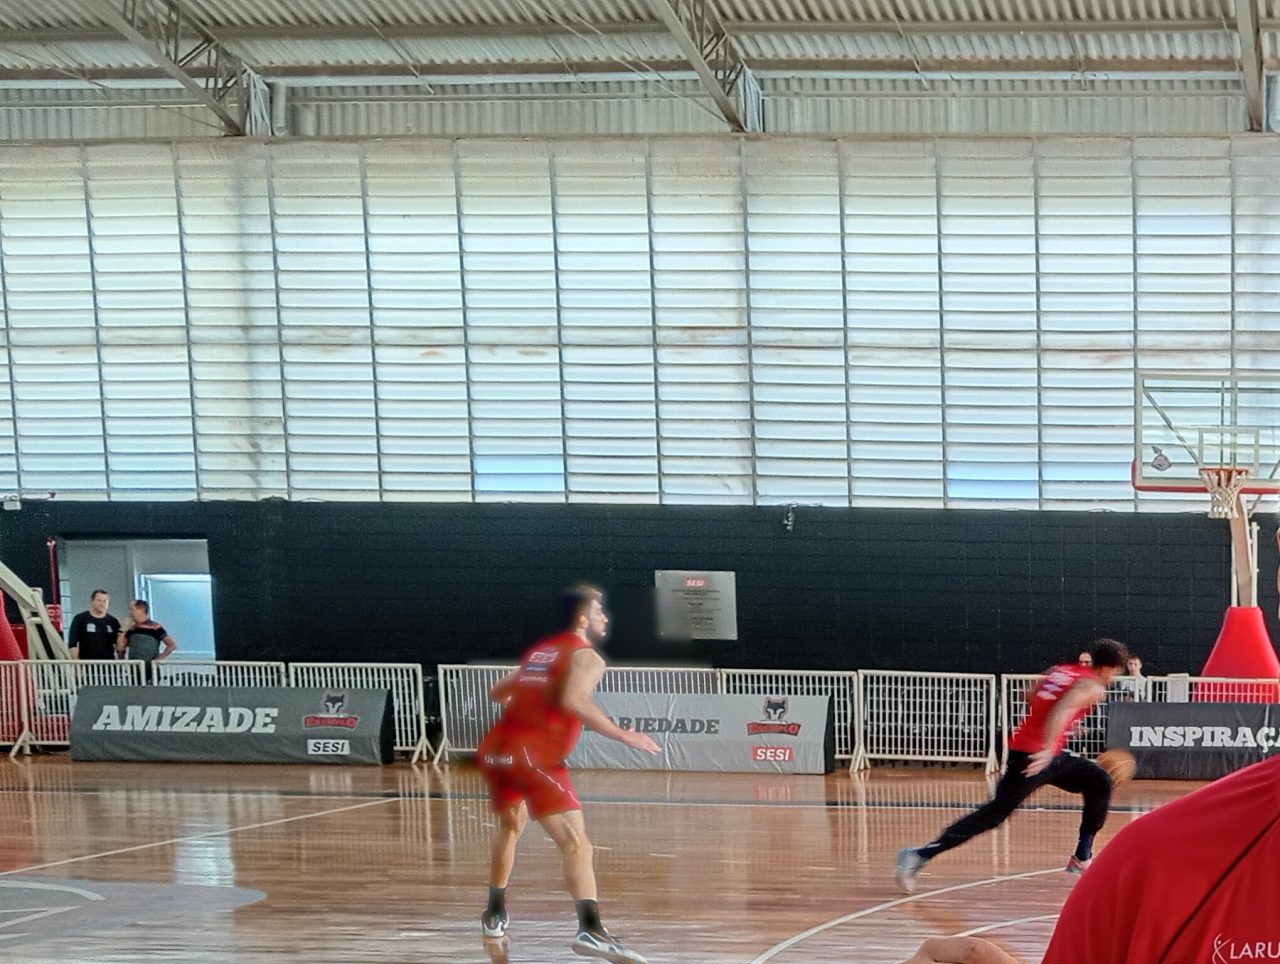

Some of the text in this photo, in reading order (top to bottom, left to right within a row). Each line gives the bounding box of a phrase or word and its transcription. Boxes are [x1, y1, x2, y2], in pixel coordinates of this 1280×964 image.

[92, 705, 279, 734] AMIZADE
[607, 716, 720, 734] RIEDADE
[312, 741, 346, 753] SESI
[756, 748, 790, 761] SESI
